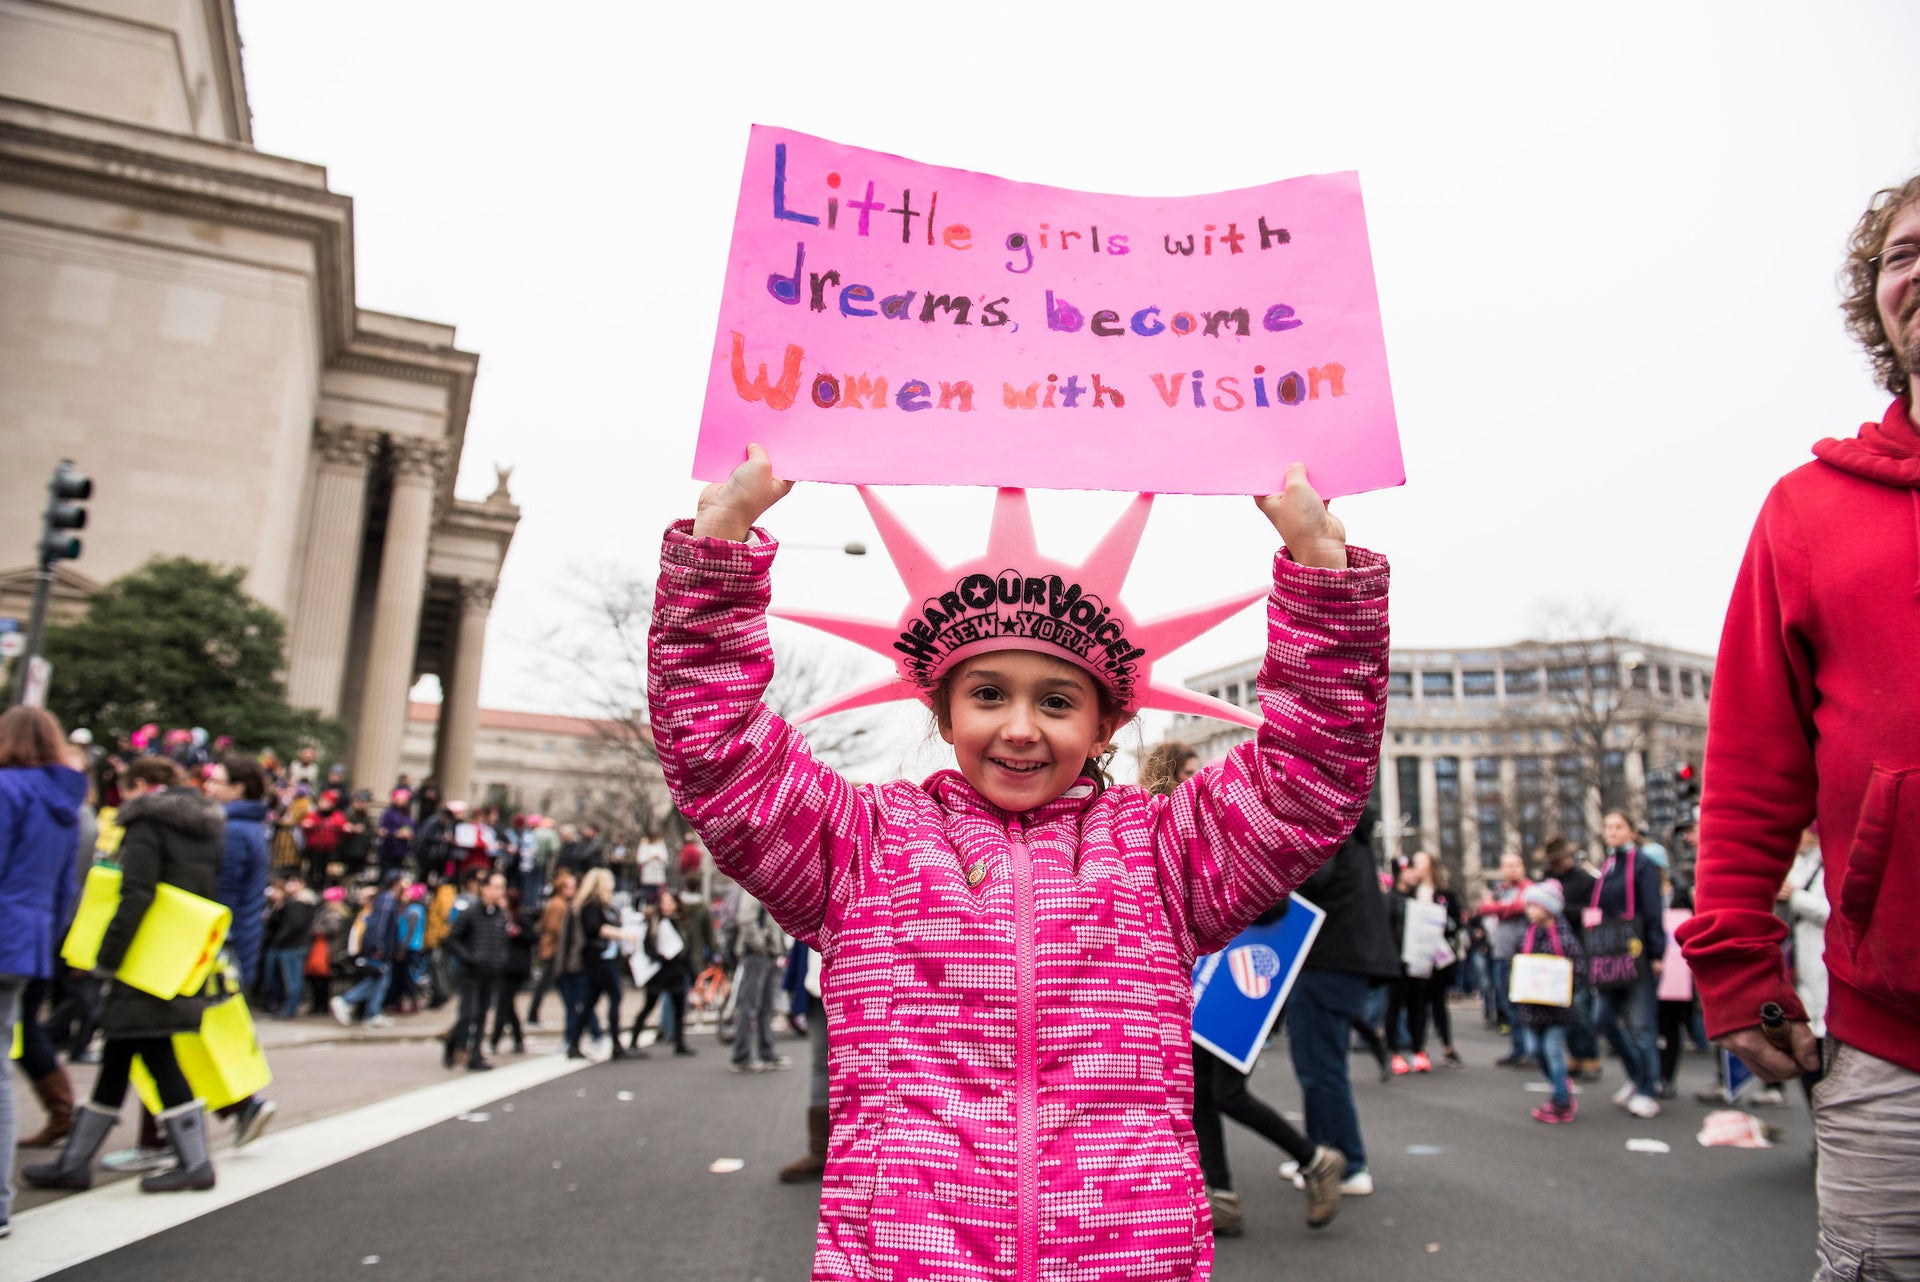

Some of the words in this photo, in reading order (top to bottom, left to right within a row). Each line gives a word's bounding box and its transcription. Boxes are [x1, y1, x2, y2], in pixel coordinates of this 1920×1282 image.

[773, 142, 974, 250] Little
[1005, 223, 1130, 273] girls
[1163, 215, 1292, 257] with
[1045, 289, 1304, 338] become
[730, 330, 975, 413] Women
[1002, 372, 1126, 410] with
[893, 591, 967, 662] HEAR
[960, 573, 1047, 609] OUR
[938, 612, 999, 651] NEW
[1016, 610, 1097, 657] YORK
